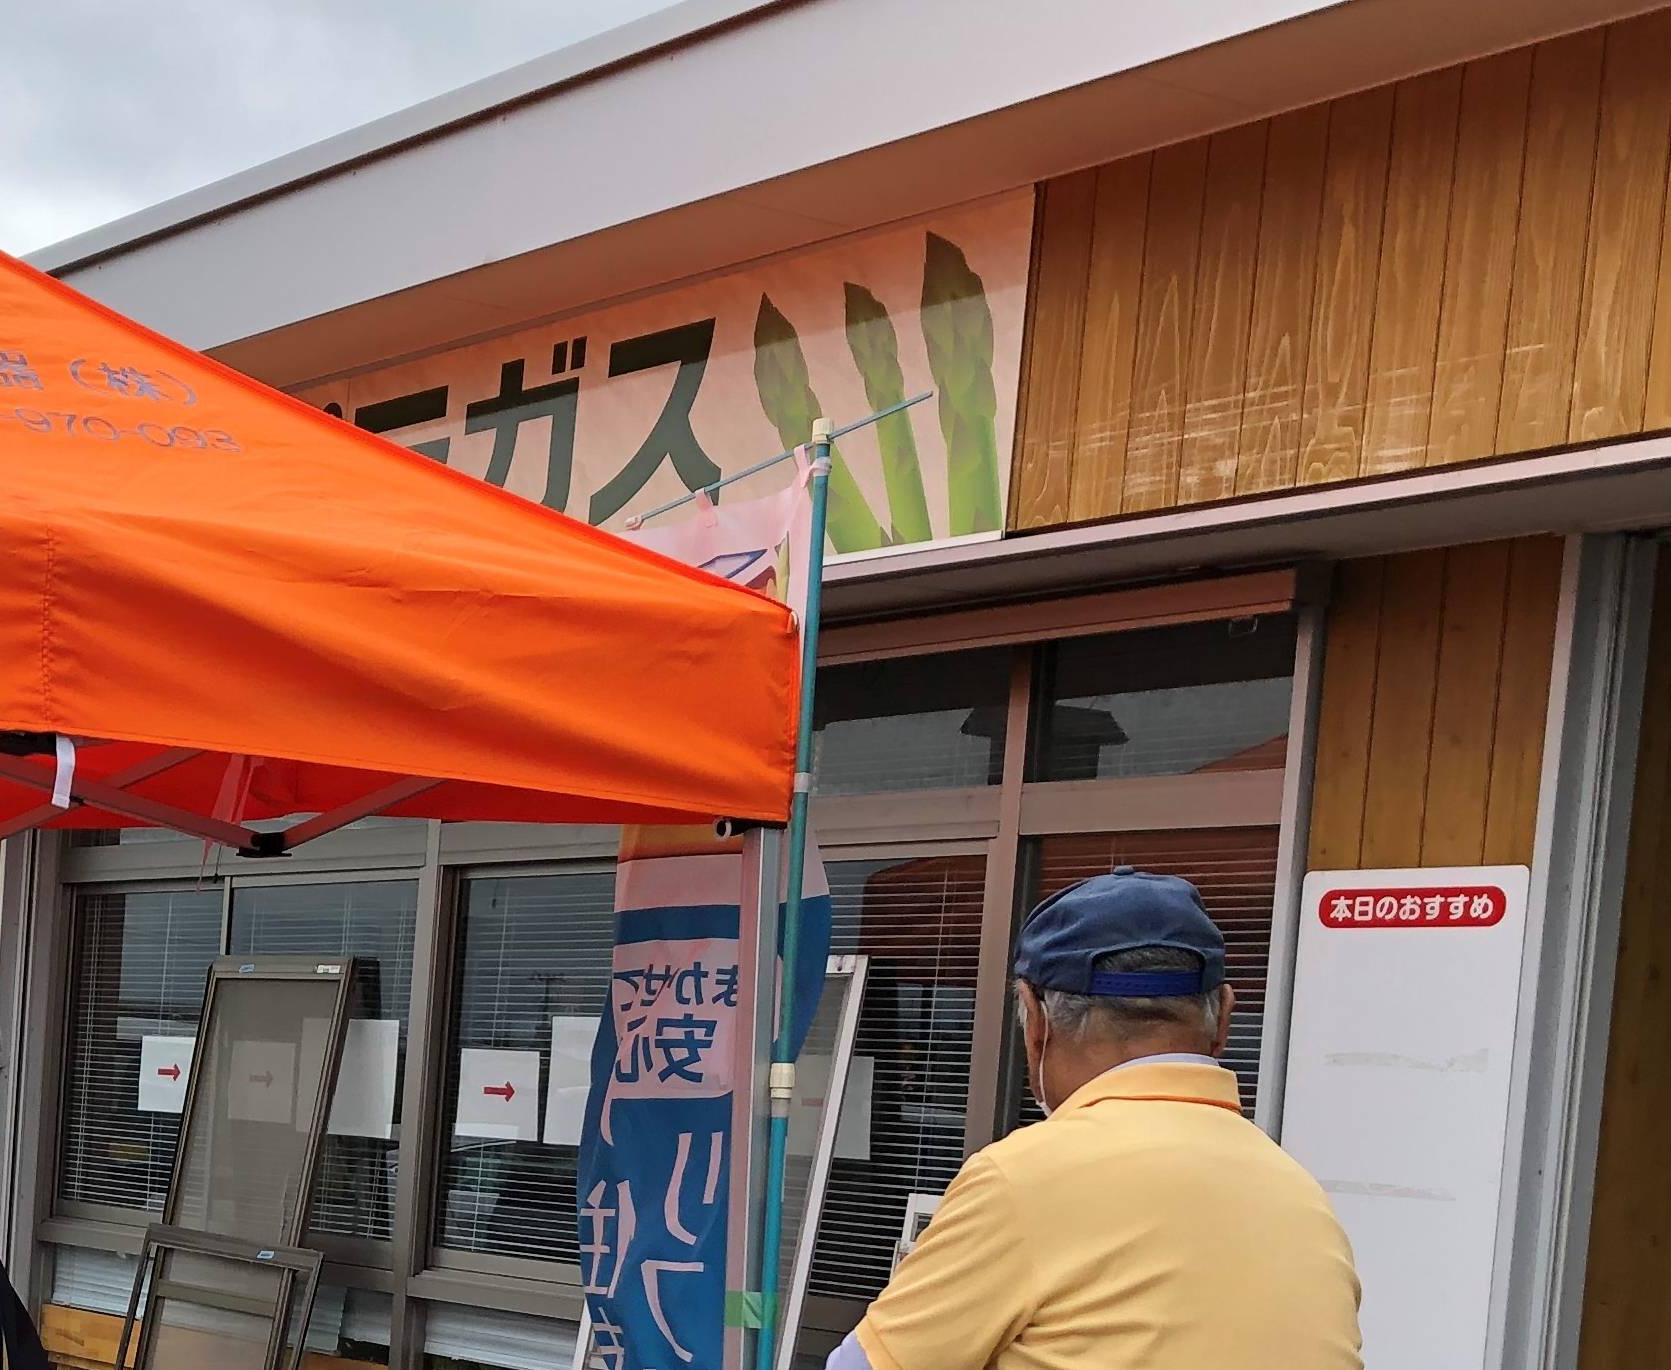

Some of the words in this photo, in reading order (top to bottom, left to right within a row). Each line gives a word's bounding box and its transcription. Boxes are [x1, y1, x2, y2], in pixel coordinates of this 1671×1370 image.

[1329, 893, 1494, 922] 本日のおすすめ
